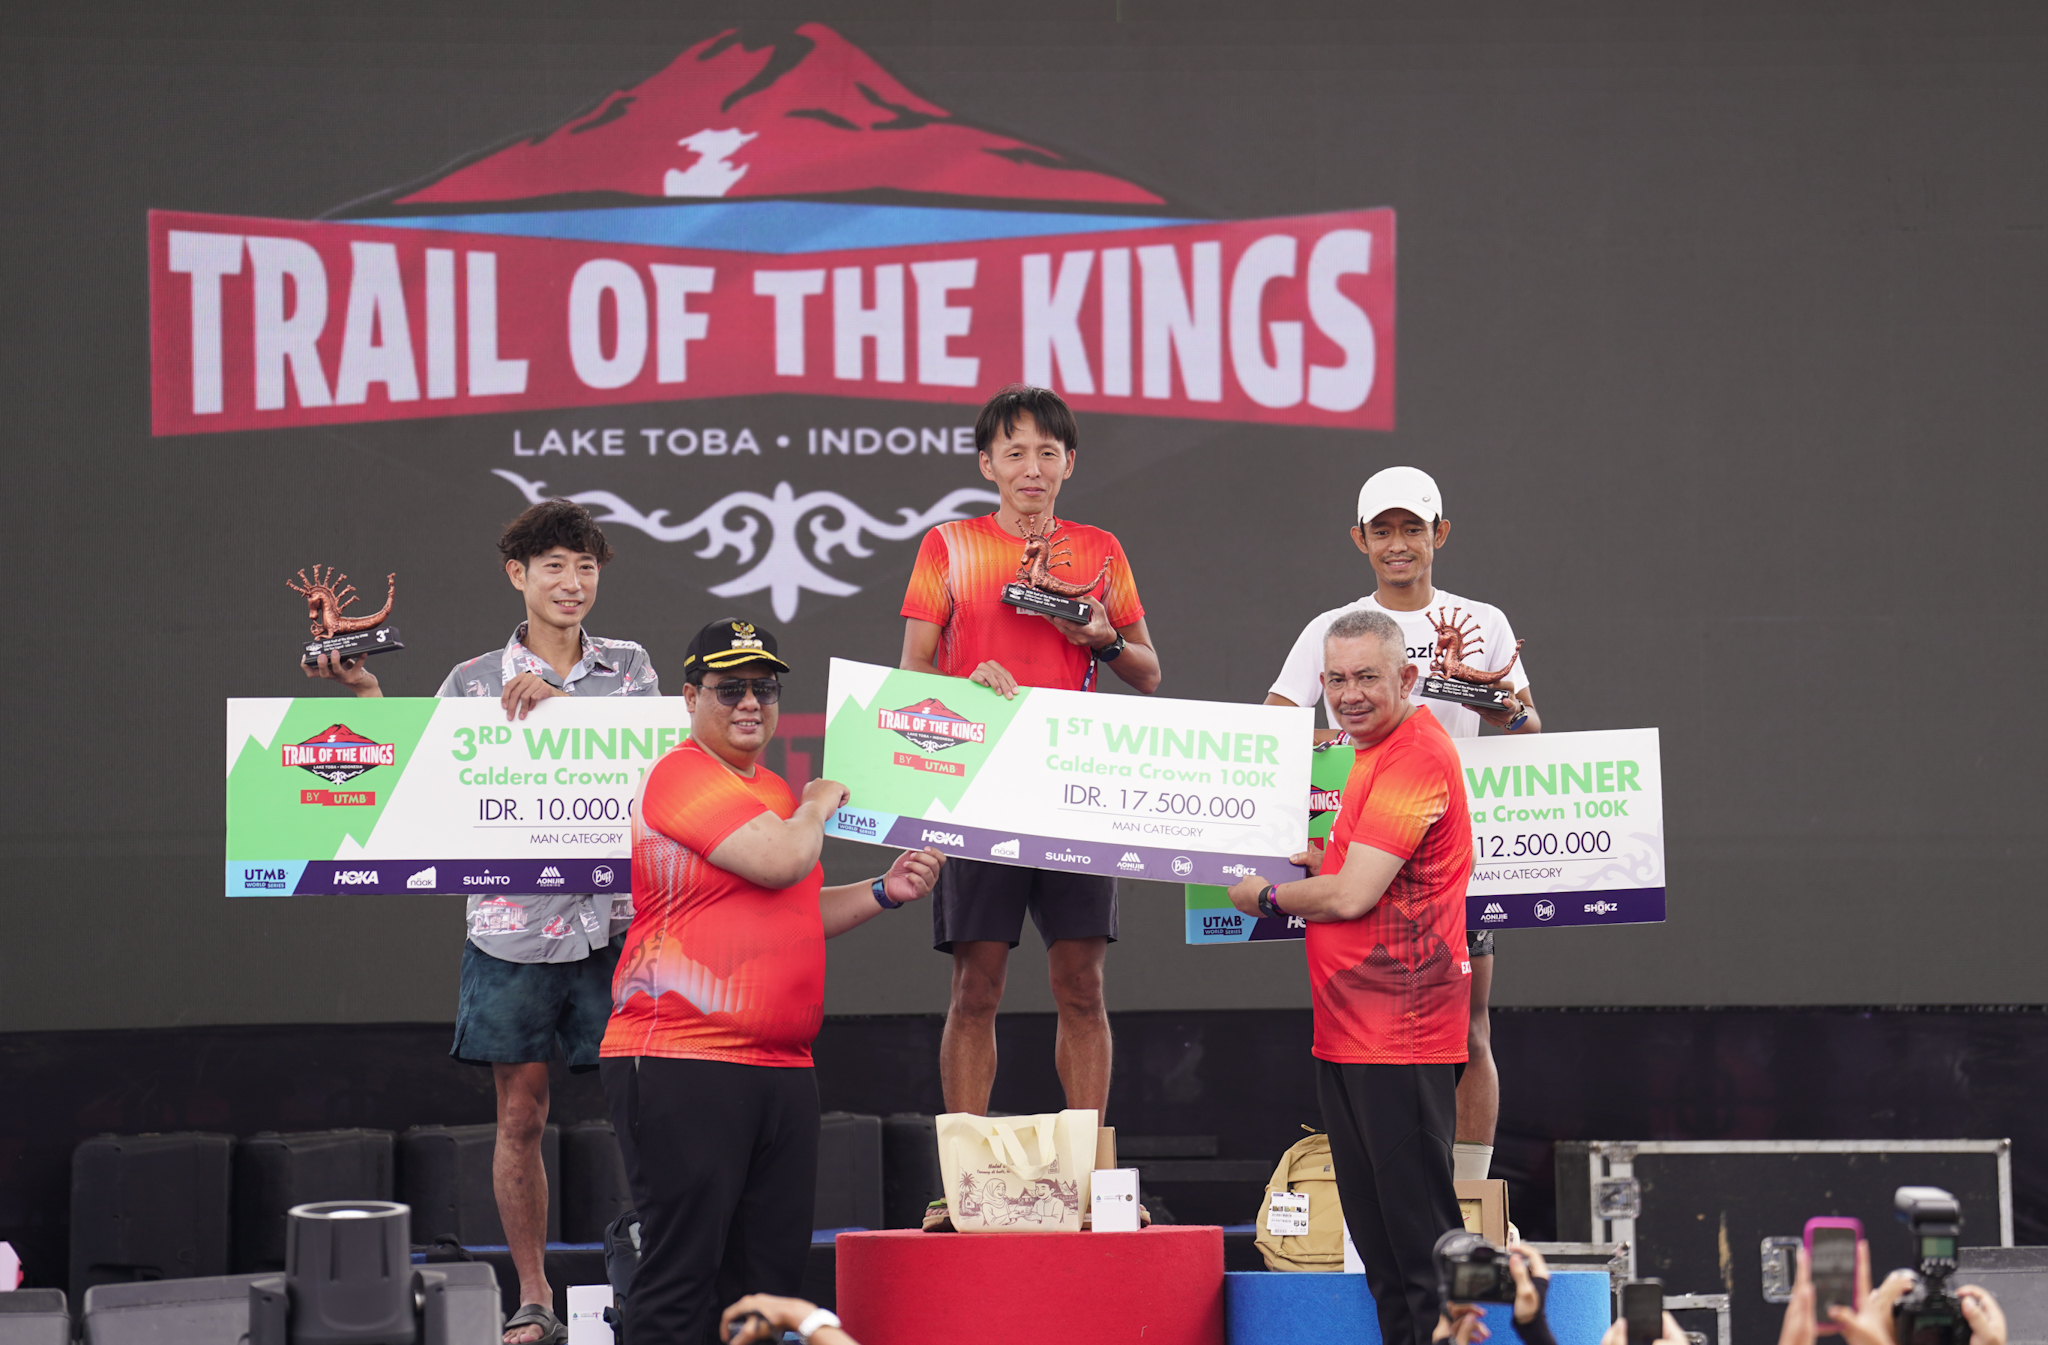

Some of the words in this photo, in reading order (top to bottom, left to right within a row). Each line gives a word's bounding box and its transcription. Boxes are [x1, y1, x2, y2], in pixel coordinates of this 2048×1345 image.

[169, 230, 528, 414] TRAIL
[568, 258, 716, 389] OF
[754, 259, 979, 387] THE
[1022, 229, 1375, 412] KINGS
[513, 429, 625, 455] LAKE
[641, 429, 760, 455] TOBA
[808, 428, 975, 455] INDONE
[376, 628, 389, 642] 3rd
[880, 710, 910, 730] TRAIL
[913, 717, 926, 731] OF
[929, 721, 949, 735] THE
[952, 723, 984, 742] KINGS
[451, 726, 512, 761] 3RD
[523, 728, 690, 759] WINNE
[1102, 723, 1280, 765] WINNER
[283, 745, 316, 765] TRAIL
[318, 748, 333, 762] OF
[335, 748, 357, 762] THE
[360, 745, 393, 765] KINGS
[899, 755, 912, 764] BY
[925, 761, 956, 773] UTMB
[1046, 755, 1132, 777] Caldera
[1139, 763, 1211, 783] Crown
[1221, 769, 1276, 788] 100K
[459, 767, 547, 785] Caldera
[554, 768, 628, 785] Crown
[1465, 760, 1642, 798] WINNER
[306, 792, 319, 801] BY
[334, 794, 366, 804] UTMB
[1064, 784, 1107, 807] IDR.
[1120, 789, 1256, 819] 17.500.000
[1310, 791, 1339, 810] KINGS
[479, 798, 524, 820] IDR.
[536, 798, 635, 820] 10.000.
[1493, 805, 1565, 822] Crown
[1573, 799, 1629, 819] 100K
[838, 812, 877, 828] UTMB
[839, 824, 858, 832] WORLD
[1112, 821, 1140, 832] MAN
[1143, 823, 1204, 837] CATEGORY
[530, 834, 559, 843] MAN
[562, 834, 623, 844] CATEGORY
[921, 829, 964, 847] HOKA
[1477, 830, 1611, 858] 12.500.000
[1045, 852, 1091, 864] SUUNTO
[1116, 862, 1144, 870] AONIJIE
[244, 869, 285, 880] UTMB
[333, 871, 379, 885] HOKA
[1222, 865, 1256, 876] SHOKZ
[1473, 870, 1500, 881] MAN
[1503, 867, 1562, 880] CATEGORY
[463, 876, 510, 885] SUUNTO
[1584, 902, 1617, 912] SHOKZ
[1203, 916, 1242, 927] UTMB
[1287, 916, 1306, 928] HO
